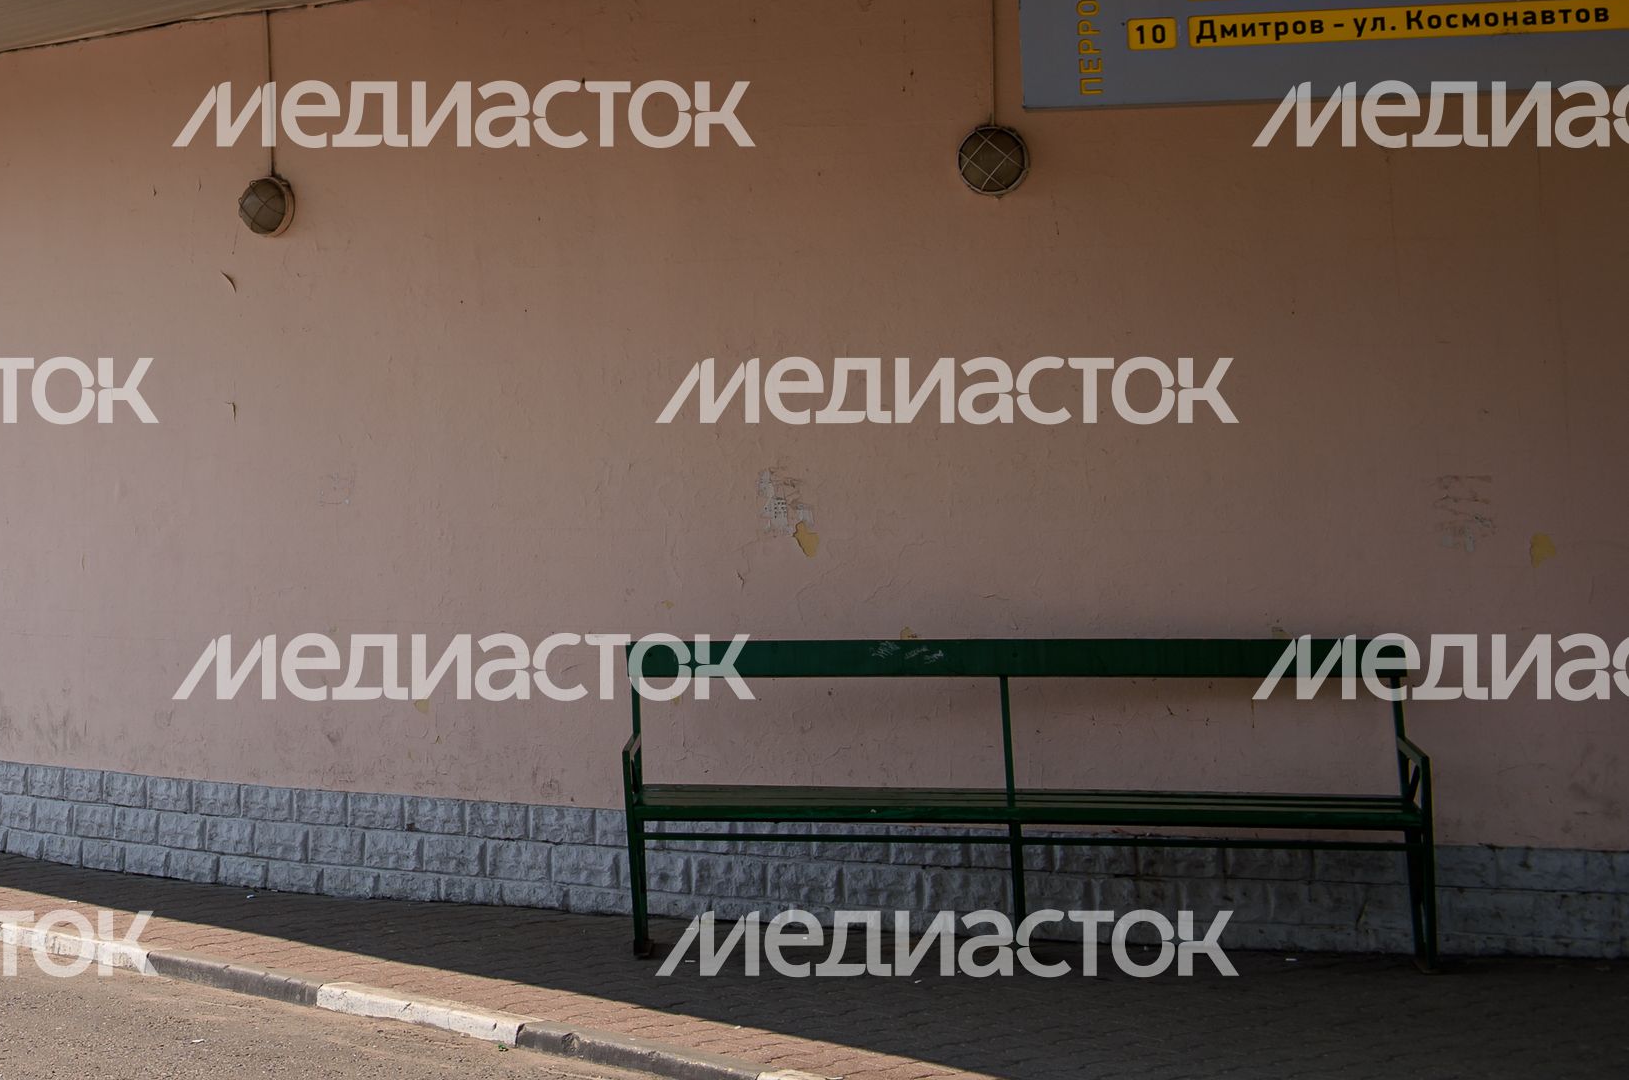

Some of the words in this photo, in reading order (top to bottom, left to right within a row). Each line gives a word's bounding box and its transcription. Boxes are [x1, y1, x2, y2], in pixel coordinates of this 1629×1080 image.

[1135, 24, 1167, 44] 10
[1196, 16, 1324, 44] Дмитров
[1353, 16, 1396, 37] ул.
[1406, 6, 1610, 30] Космонавтов
